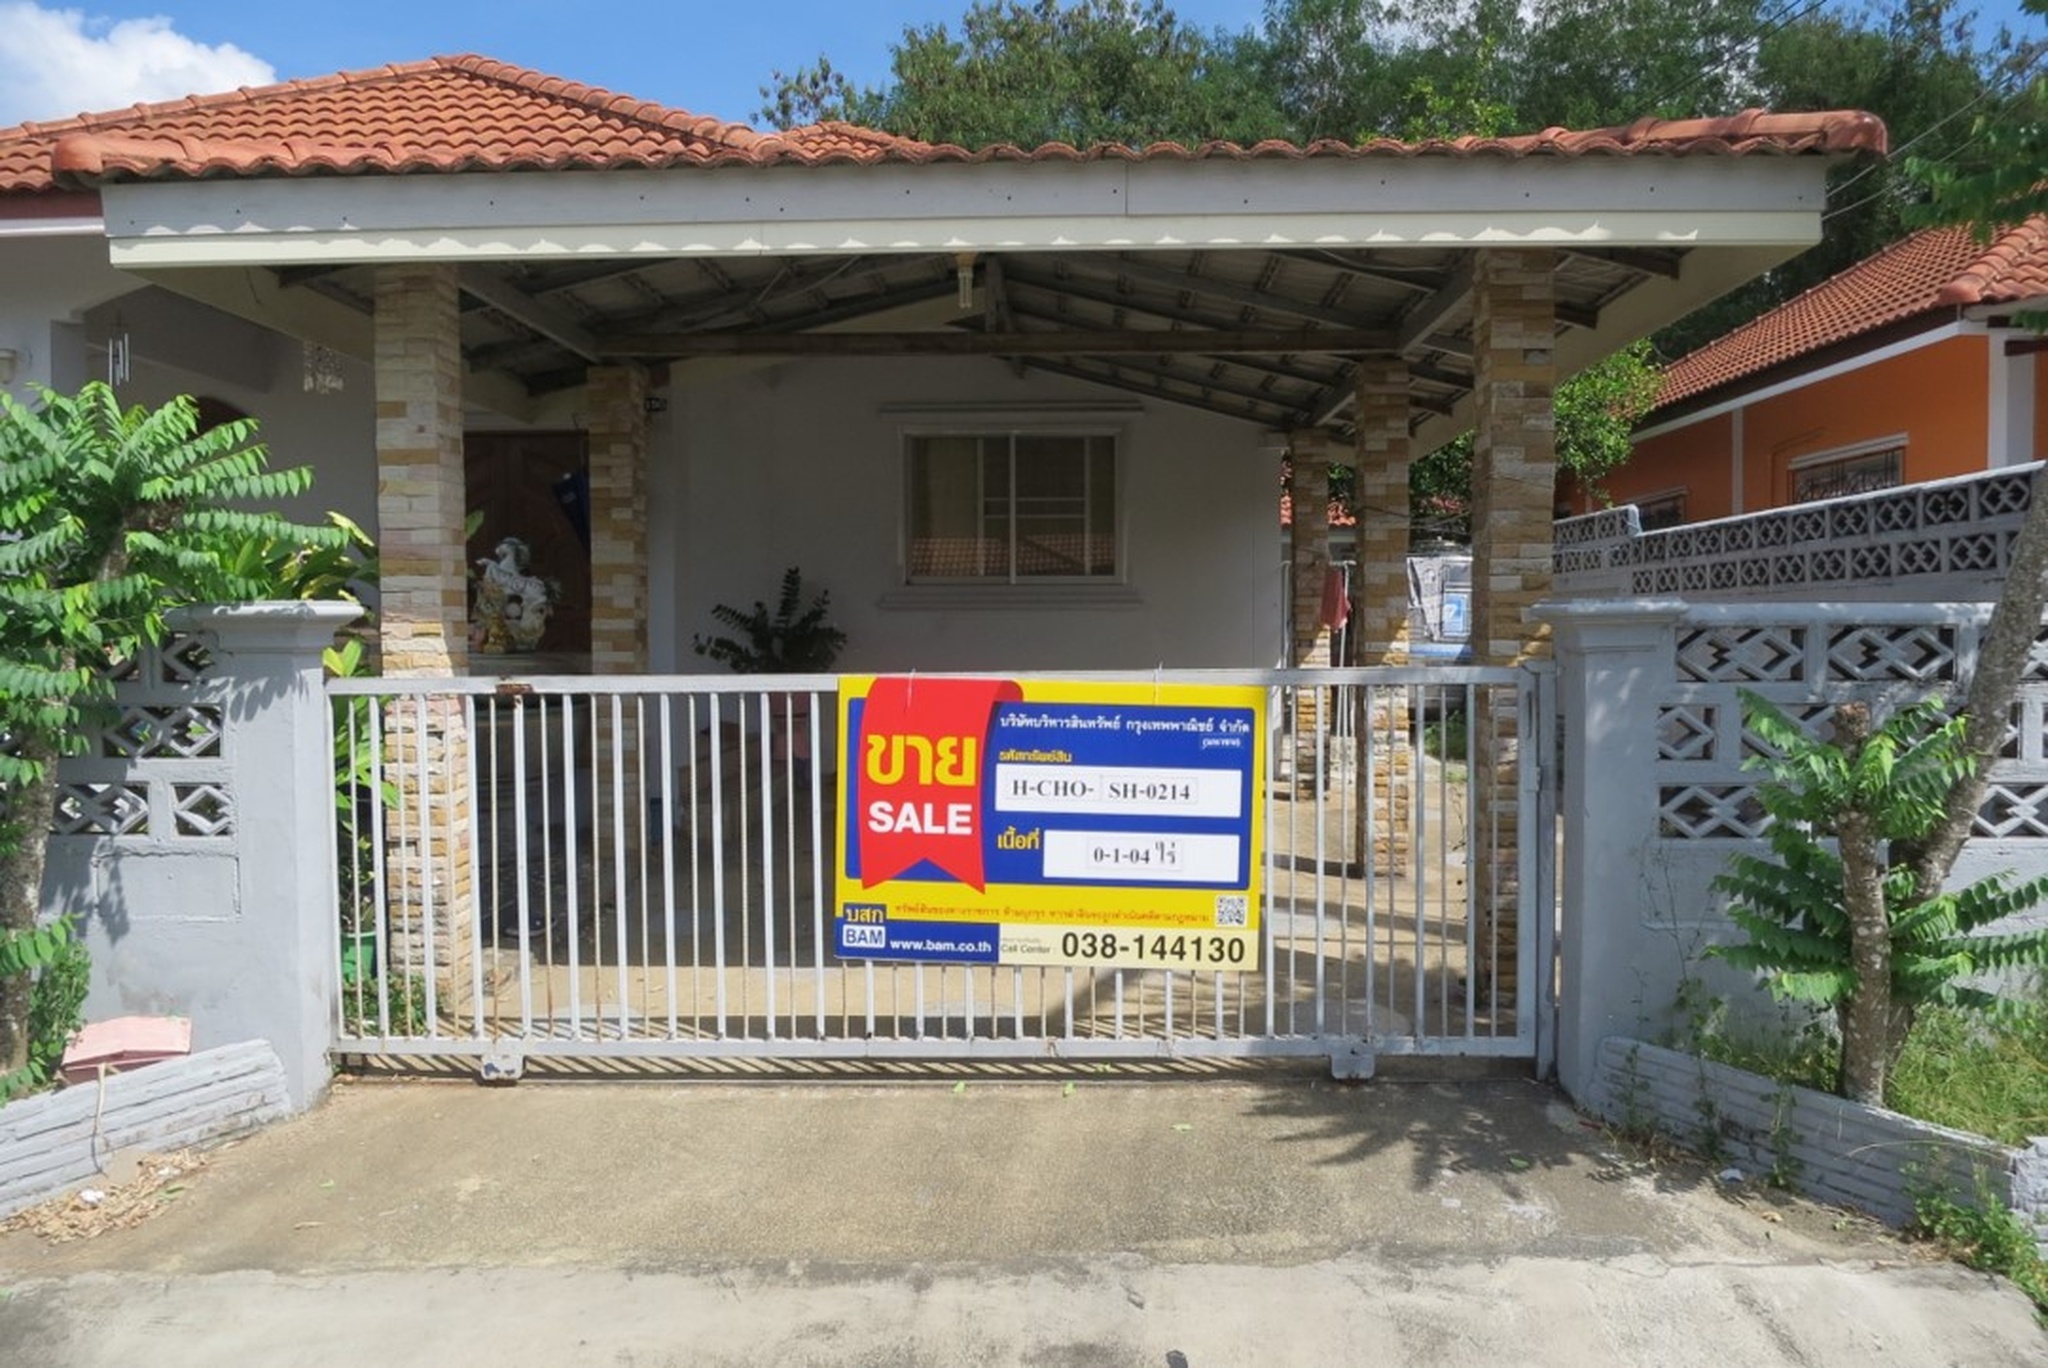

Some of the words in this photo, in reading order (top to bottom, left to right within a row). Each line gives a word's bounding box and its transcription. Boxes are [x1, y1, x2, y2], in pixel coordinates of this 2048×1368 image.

[1219, 719, 1250, 733] จำกัด
[867, 734, 977, 787] ขาย
[1012, 780, 1094, 797] H-CHO-
[1109, 782, 1191, 800] SH-0214
[868, 801, 973, 835] SALE
[997, 826, 1040, 849] เนื้อที่
[1094, 847, 1151, 865] 0-1-04
[846, 907, 884, 924] บสก
[845, 928, 883, 945] BAM
[890, 939, 992, 953] www.bam.co.th
[1062, 931, 1245, 963] 038-144130
